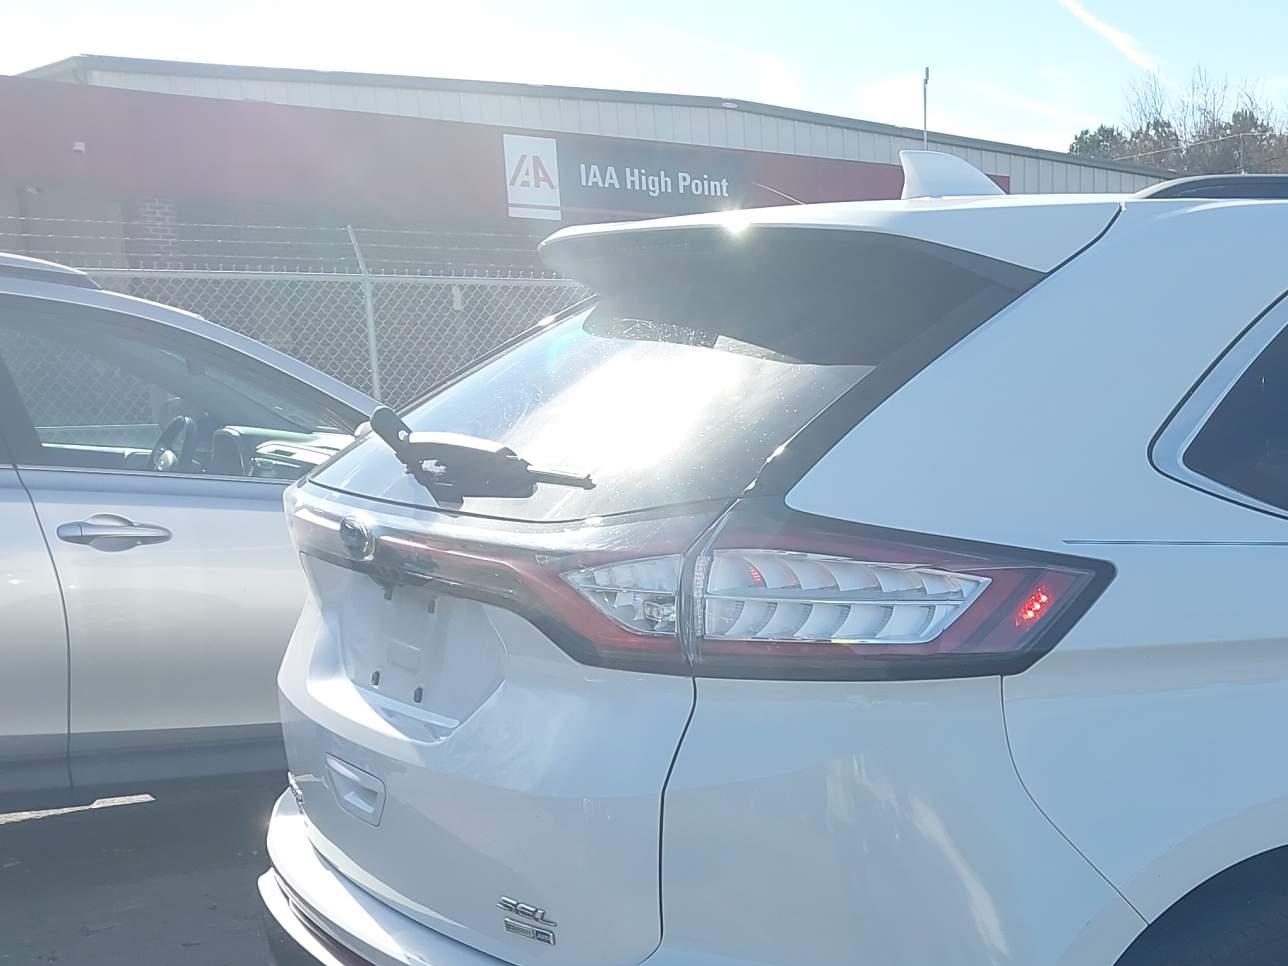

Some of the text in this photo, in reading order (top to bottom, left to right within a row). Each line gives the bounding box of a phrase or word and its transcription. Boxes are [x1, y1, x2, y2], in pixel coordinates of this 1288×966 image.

[580, 163, 729, 197] IAA High Point
[496, 896, 557, 928] SEL
